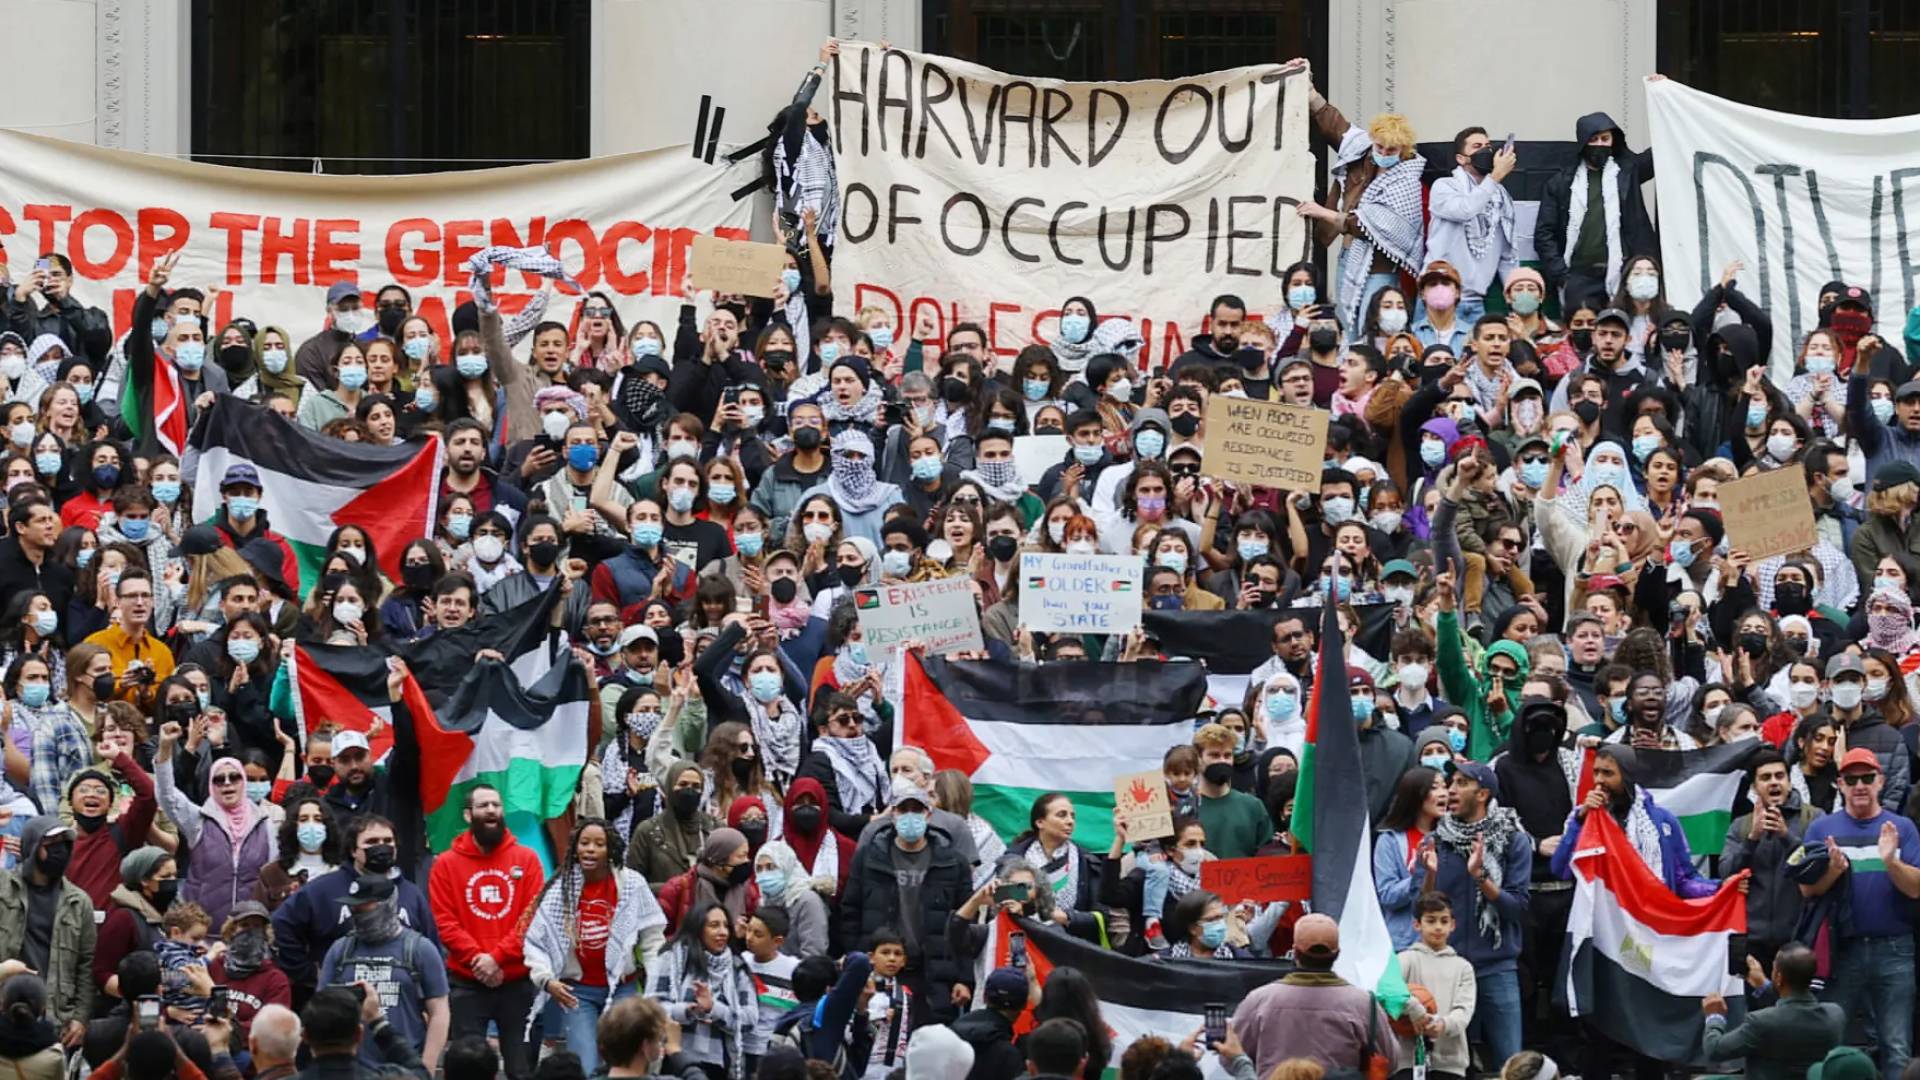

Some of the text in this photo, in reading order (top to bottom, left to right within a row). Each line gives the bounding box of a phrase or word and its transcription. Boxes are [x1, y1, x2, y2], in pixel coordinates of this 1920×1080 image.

[832, 46, 1306, 168] HARVARD OUT
[842, 182, 1313, 278] OF OCCUPIED
[209, 211, 362, 288] THE
[385, 216, 751, 298] GENOCI
[1227, 404, 1312, 430] WHEN PEOPLE
[1227, 422, 1315, 446] ARE OCCUPIED
[1223, 440, 1294, 462] RESISTANCE
[1226, 461, 1315, 483] IS JUSTIFIED
[1024, 555, 1042, 568] MY
[887, 581, 971, 605] EXISTENCE
[910, 604, 929, 618] IS
